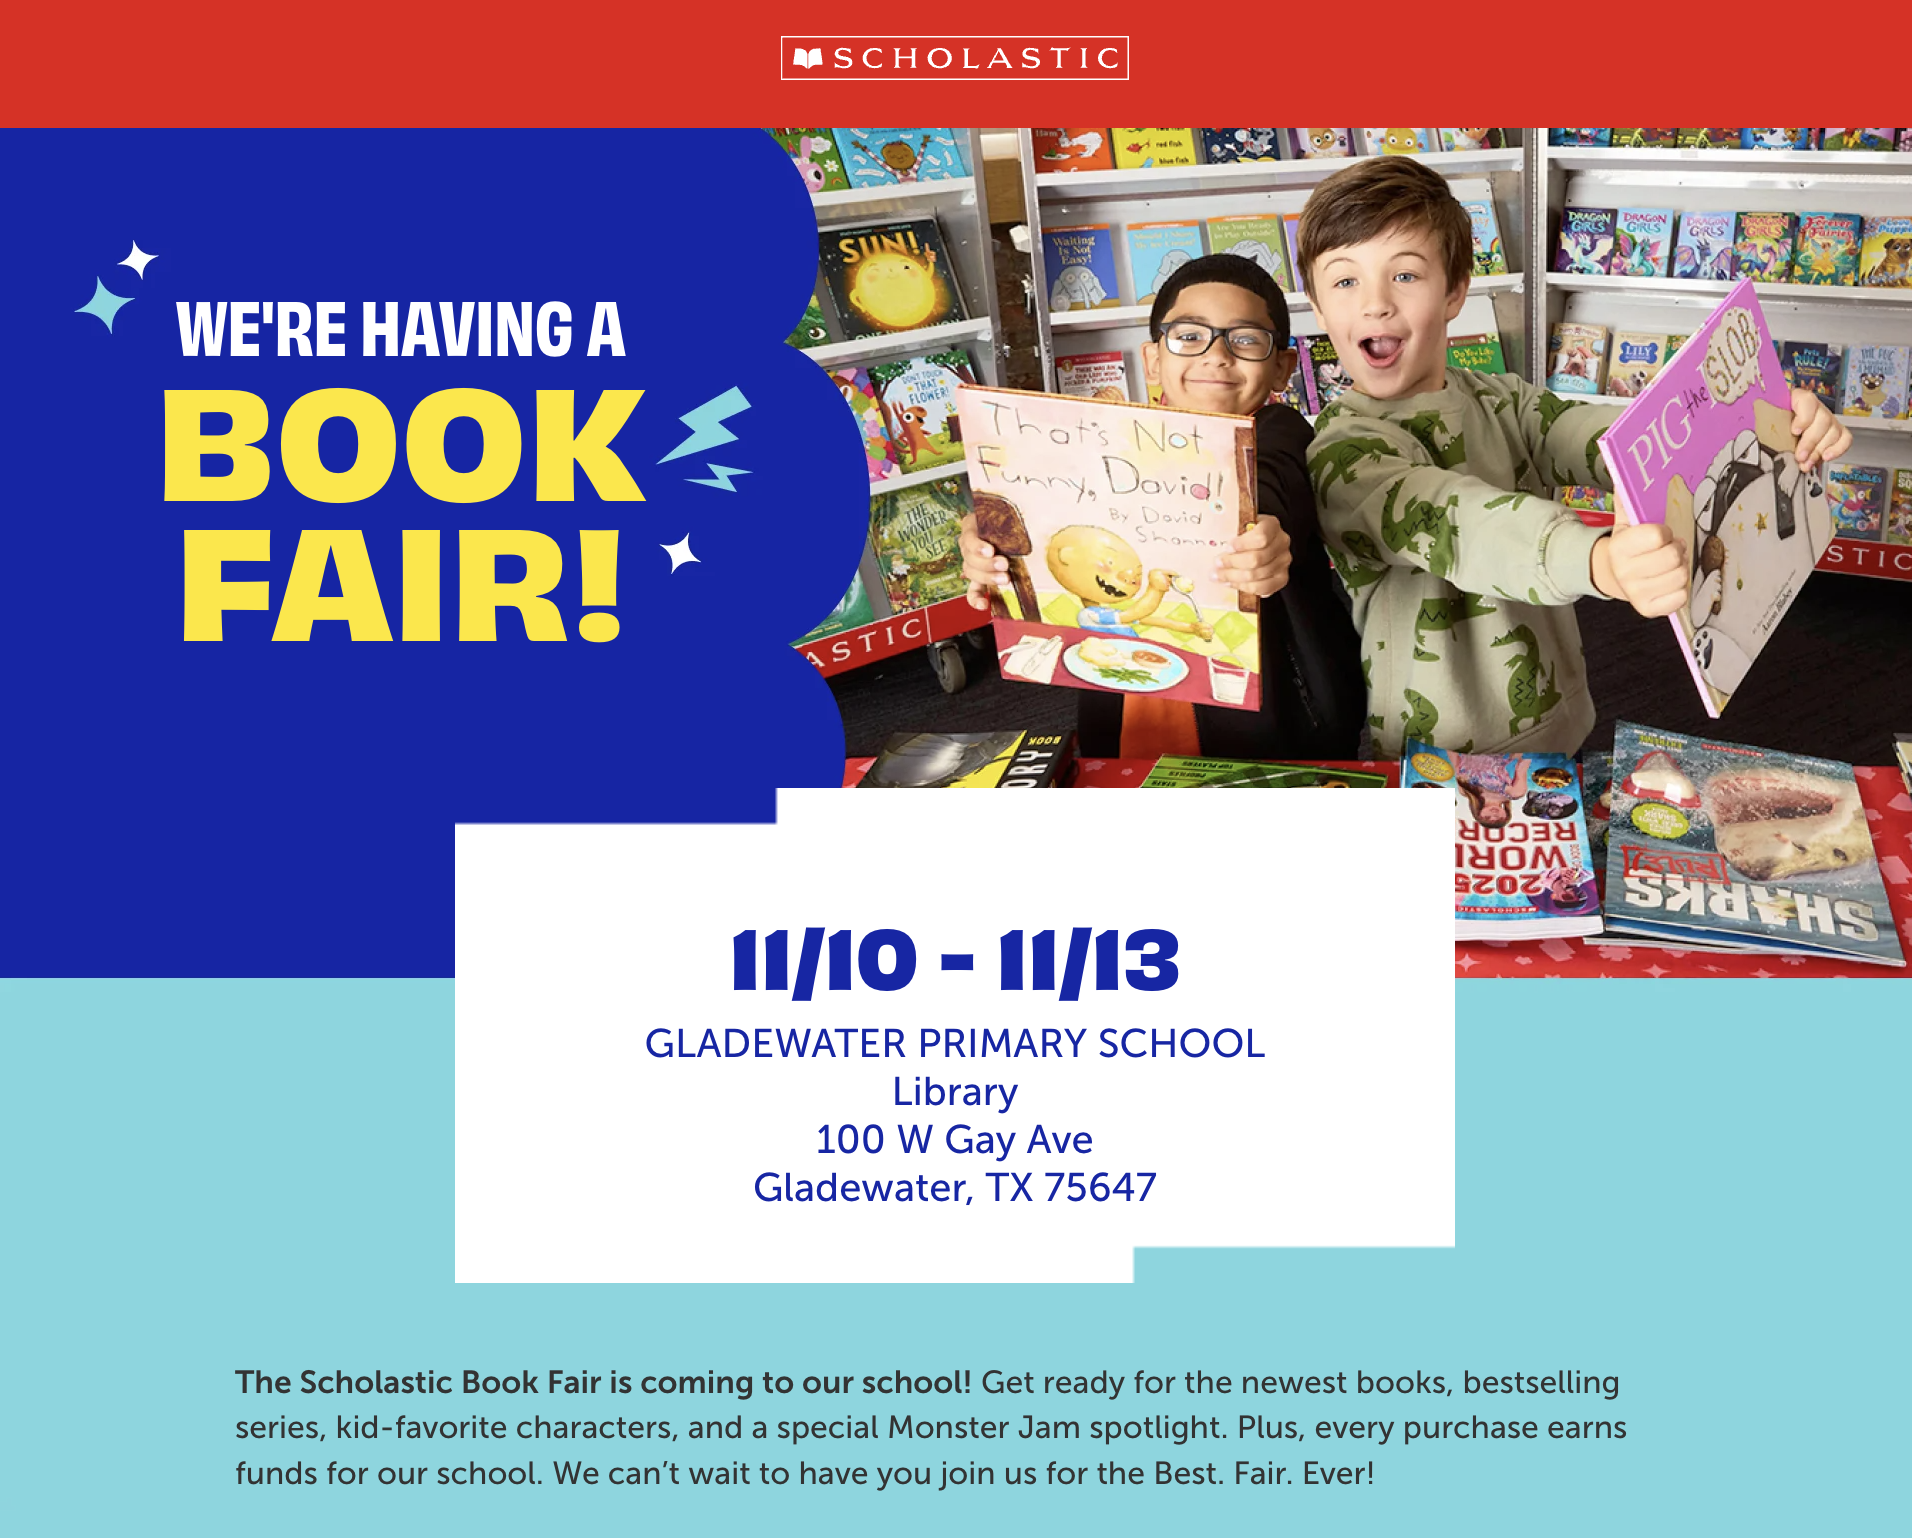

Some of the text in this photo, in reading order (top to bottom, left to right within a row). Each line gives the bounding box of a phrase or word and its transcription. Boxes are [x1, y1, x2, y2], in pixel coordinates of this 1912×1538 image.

[1568, 211, 1611, 224] DRAGON
[1623, 212, 1667, 224] DRAGON
[1686, 216, 1730, 227] DRAGON
[1741, 215, 1788, 229] DRAGON
[1805, 215, 1854, 229] Forever
[1571, 220, 1606, 233] GIRLS
[1626, 221, 1661, 234] GIRLS
[1689, 225, 1724, 237] GIRLS
[1744, 226, 1783, 238] GIRLS
[839, 231, 920, 263] SUN!
[1053, 235, 1096, 247] Waiting
[1626, 345, 1652, 356] LILY
[1794, 355, 1830, 369] RULE!
[915, 379, 938, 392] THAT
[909, 387, 949, 405] FLOWER!
[1627, 395, 1692, 491] PIG
[1683, 386, 1709, 418] the
[1706, 313, 1757, 397] SLOB
[982, 401, 1203, 453] That's Not
[978, 446, 1226, 512] Funny, David!
[905, 503, 930, 525] THE
[1109, 506, 1203, 525] By David
[897, 510, 948, 542] WONDER
[911, 531, 934, 552] YOU
[925, 538, 947, 559] SEE
[1028, 736, 1062, 746] BOOK
[1455, 873, 1542, 895] 2025
[1624, 868, 1879, 941] SHARKS
